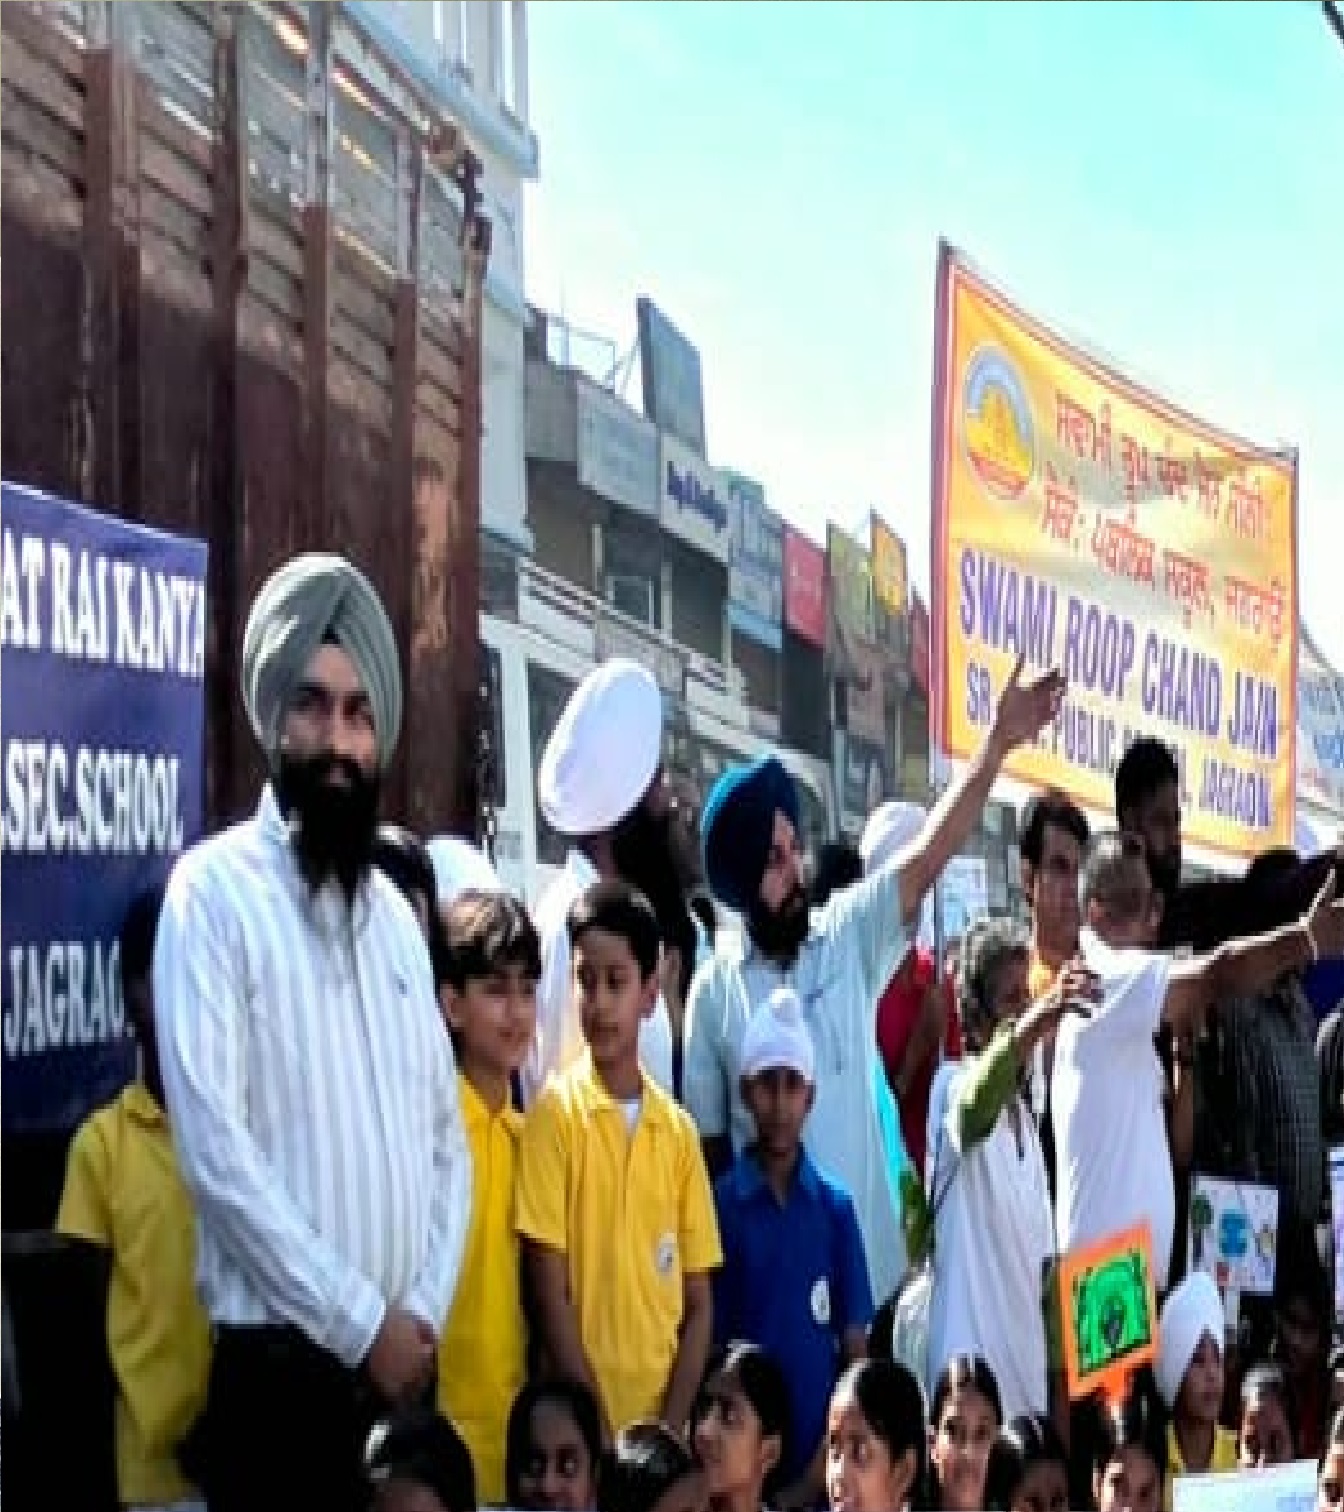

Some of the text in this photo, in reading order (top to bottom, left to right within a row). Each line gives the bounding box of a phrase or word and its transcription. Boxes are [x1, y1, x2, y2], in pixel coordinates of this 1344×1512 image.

[51, 542, 109, 659] RAI
[113, 562, 205, 683] KANYA
[961, 548, 1057, 670] SWAMI
[1064, 596, 1135, 701] ROOP
[1141, 629, 1223, 736] CHAND
[1228, 672, 1277, 759] JAIN
[4, 937, 136, 1060] JAGRAO
